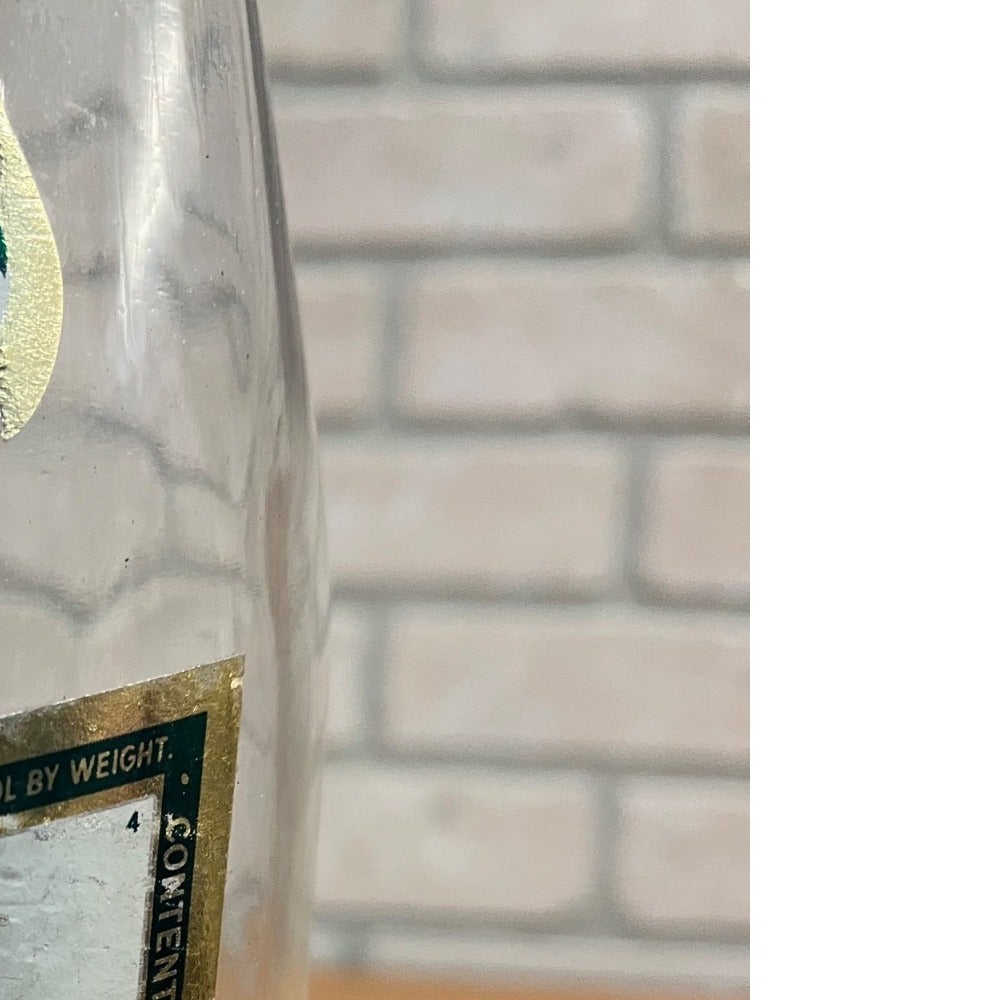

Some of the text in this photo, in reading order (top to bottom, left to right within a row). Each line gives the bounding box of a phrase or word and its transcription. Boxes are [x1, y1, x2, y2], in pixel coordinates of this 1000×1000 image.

[26, 763, 60, 797] BY
[70, 735, 174, 785] WEIGHT.
[126, 811, 140, 833] 4
